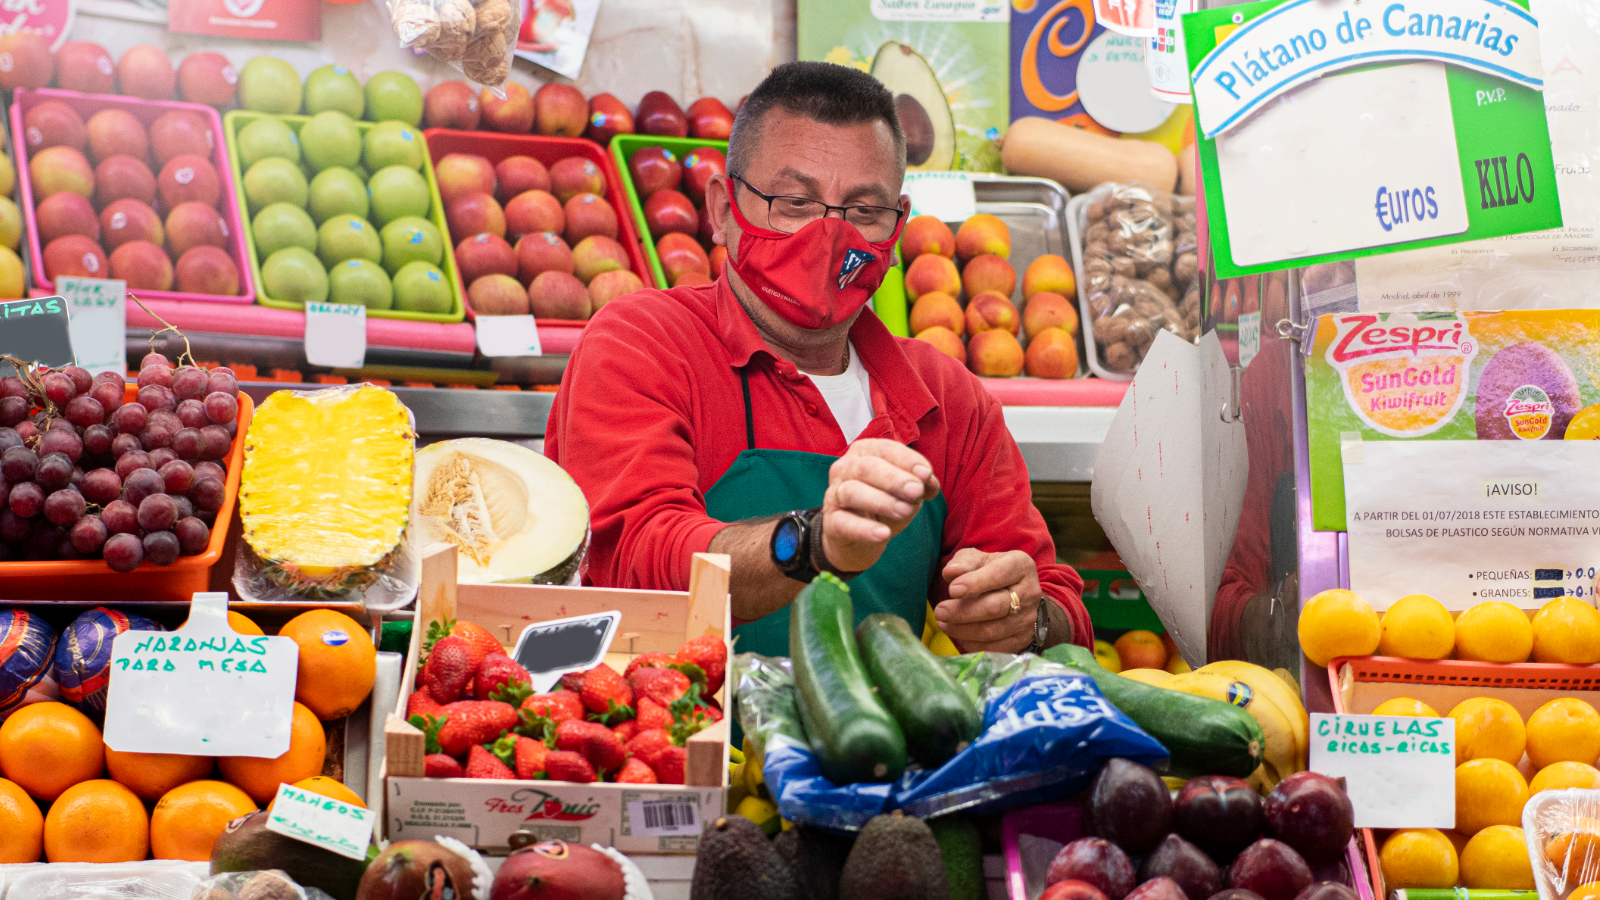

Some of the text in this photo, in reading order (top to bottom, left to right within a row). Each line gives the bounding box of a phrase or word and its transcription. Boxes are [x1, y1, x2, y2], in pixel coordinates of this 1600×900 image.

[1214, 3, 1519, 101] Plátano de Canarias
[1475, 88, 1507, 106] P.V.P.
[1474, 152, 1536, 209] KILO
[1412, 291, 1430, 299] abril
[0, 299, 61, 319] ITAS
[1333, 315, 1463, 363] Zespri
[1361, 365, 1456, 393] SunGold
[1371, 392, 1447, 412] Kiwifruit
[1505, 399, 1550, 417] Zespri
[1515, 416, 1548, 427] SunGold
[1486, 483, 1538, 497] ¡AVISO!
[1354, 509, 1600, 521] A PARTIR DEL 01/07/2018 ESTE ESTABLECIMIENTO
[1386, 528, 1424, 538] BOLSAS
[1426, 528, 1439, 537] DE
[1442, 527, 1489, 537] PLASTICO
[1491, 525, 1525, 537] SEGÚN
[1528, 527, 1589, 536] NORMATIVA
[1476, 569, 1533, 581] PEQUEÑAS:
[1480, 588, 1531, 598] GRANDES:
[134, 636, 269, 655] NARANJAS
[116, 658, 268, 673] PARA MESA
[1317, 719, 1444, 737] CIRUELAS
[1327, 738, 1451, 755] RICAS-RICAS
[282, 788, 367, 821] MANGOS
